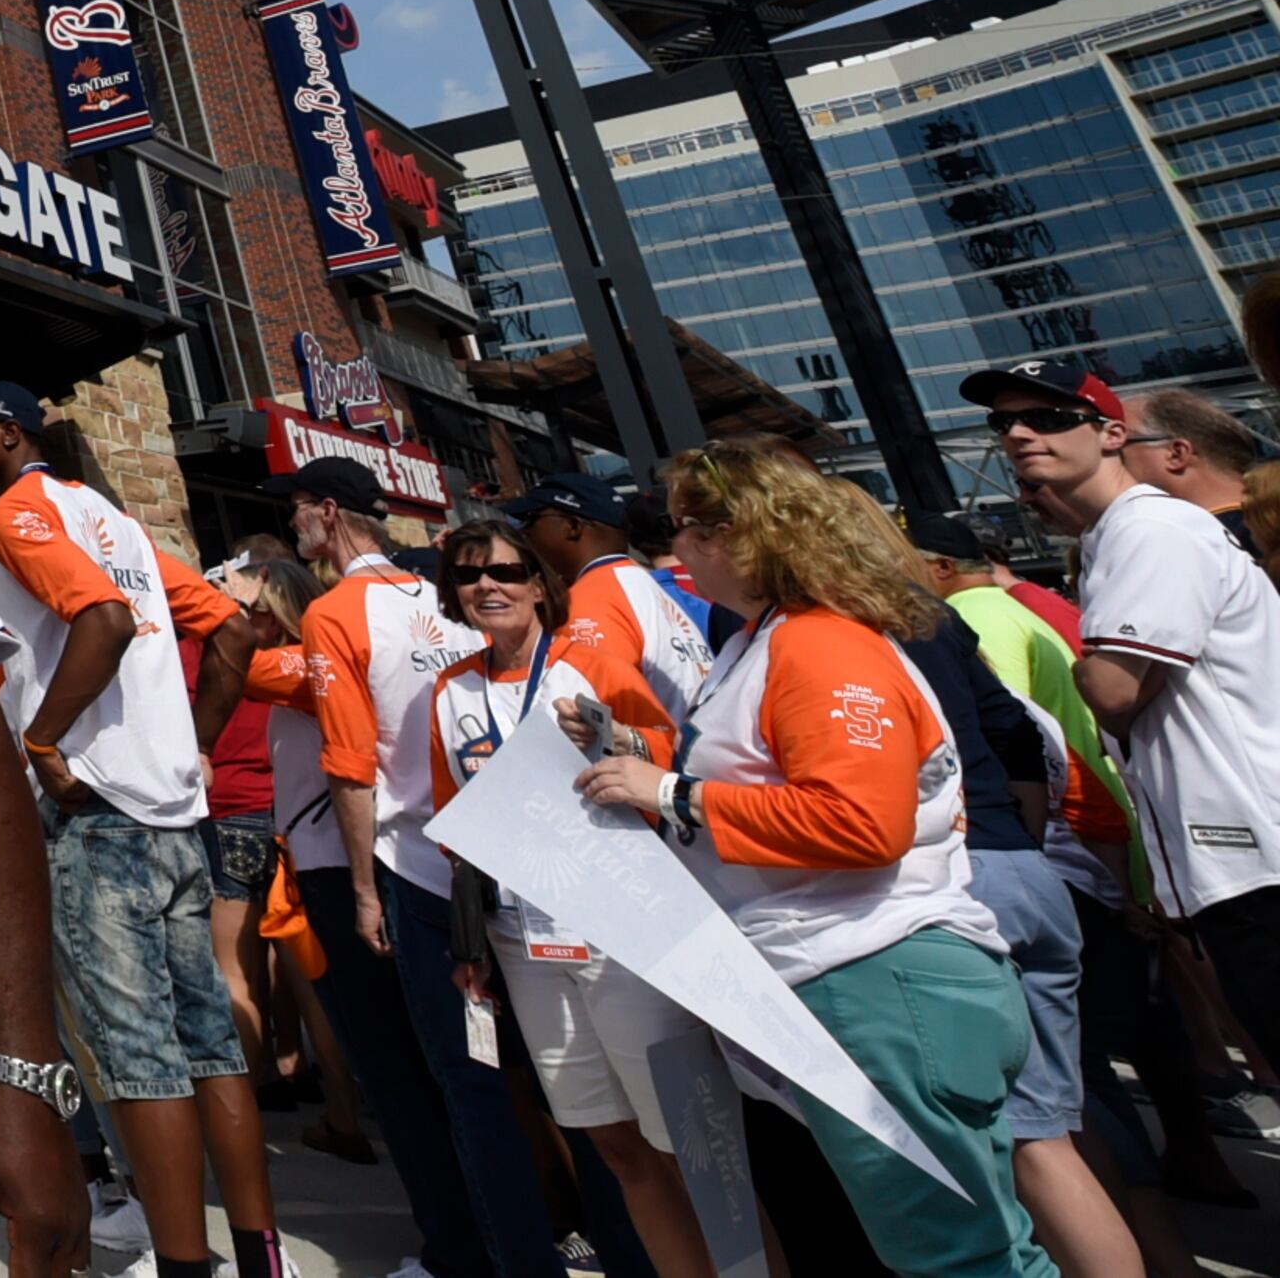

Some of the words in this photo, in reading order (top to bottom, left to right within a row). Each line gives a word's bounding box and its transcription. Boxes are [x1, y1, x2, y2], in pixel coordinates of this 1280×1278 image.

[293, 10, 347, 114] Braves
[312, 114, 381, 250] Atlanta
[293, 331, 381, 420] Braves
[388, 447, 448, 505] STORE
[843, 683, 872, 695] TEAM
[542, 946, 576, 959] GUEST
